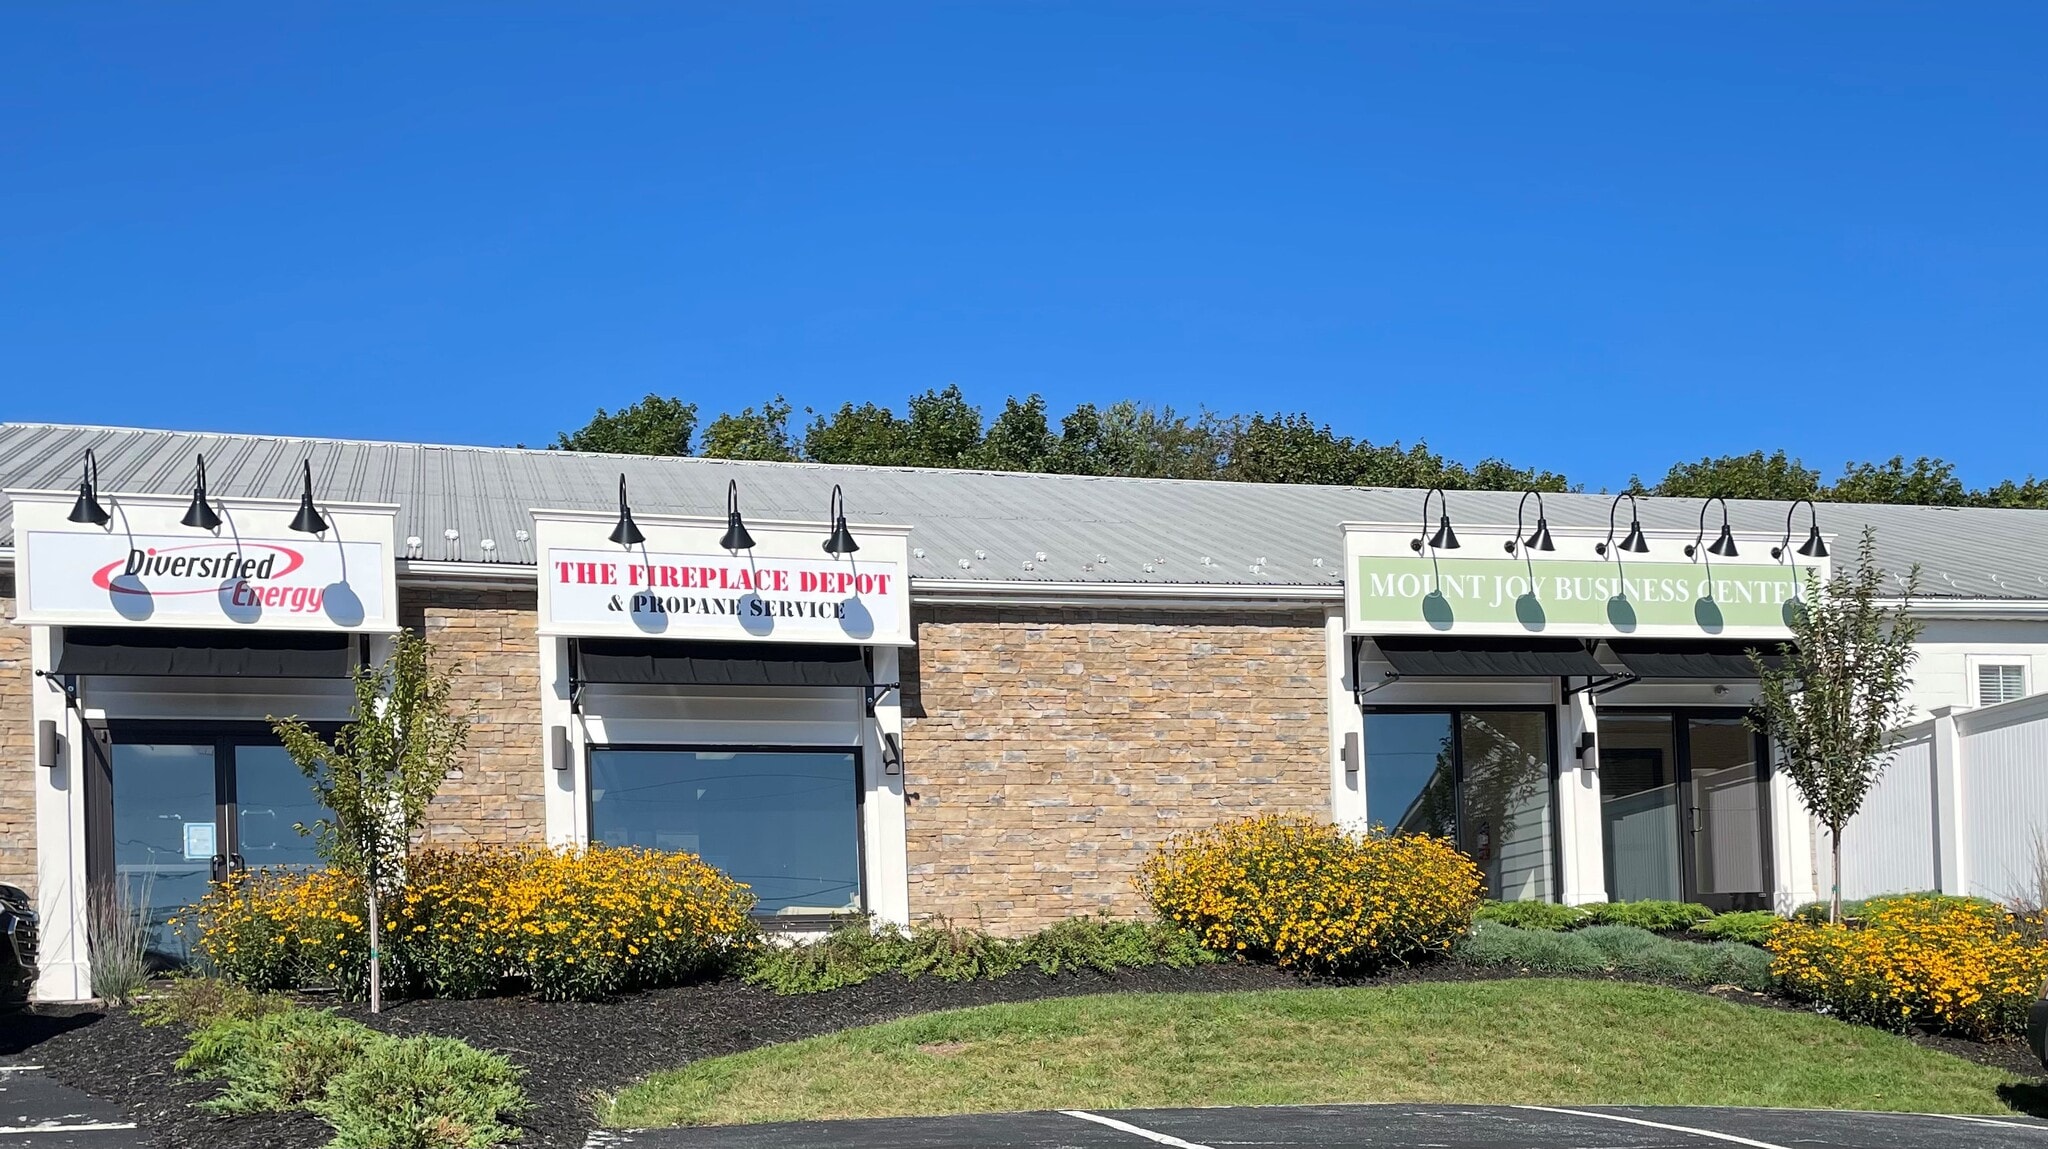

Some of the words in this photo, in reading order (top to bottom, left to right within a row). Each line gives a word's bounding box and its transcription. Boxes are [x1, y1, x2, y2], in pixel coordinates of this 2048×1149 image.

[124, 548, 275, 579] Diversified
[555, 562, 617, 585] THE
[628, 564, 789, 591] FIREPLACE
[800, 571, 891, 596] DEPOT
[231, 580, 324, 613] Energy
[607, 594, 624, 612] &
[632, 595, 741, 616] PROPANE
[750, 598, 845, 619] SERVICE
[1369, 573, 1486, 599] MOUNT
[1489, 577, 1546, 608] JOY
[1555, 577, 1689, 602] BUSINESS
[1696, 580, 1808, 605] CENTER
